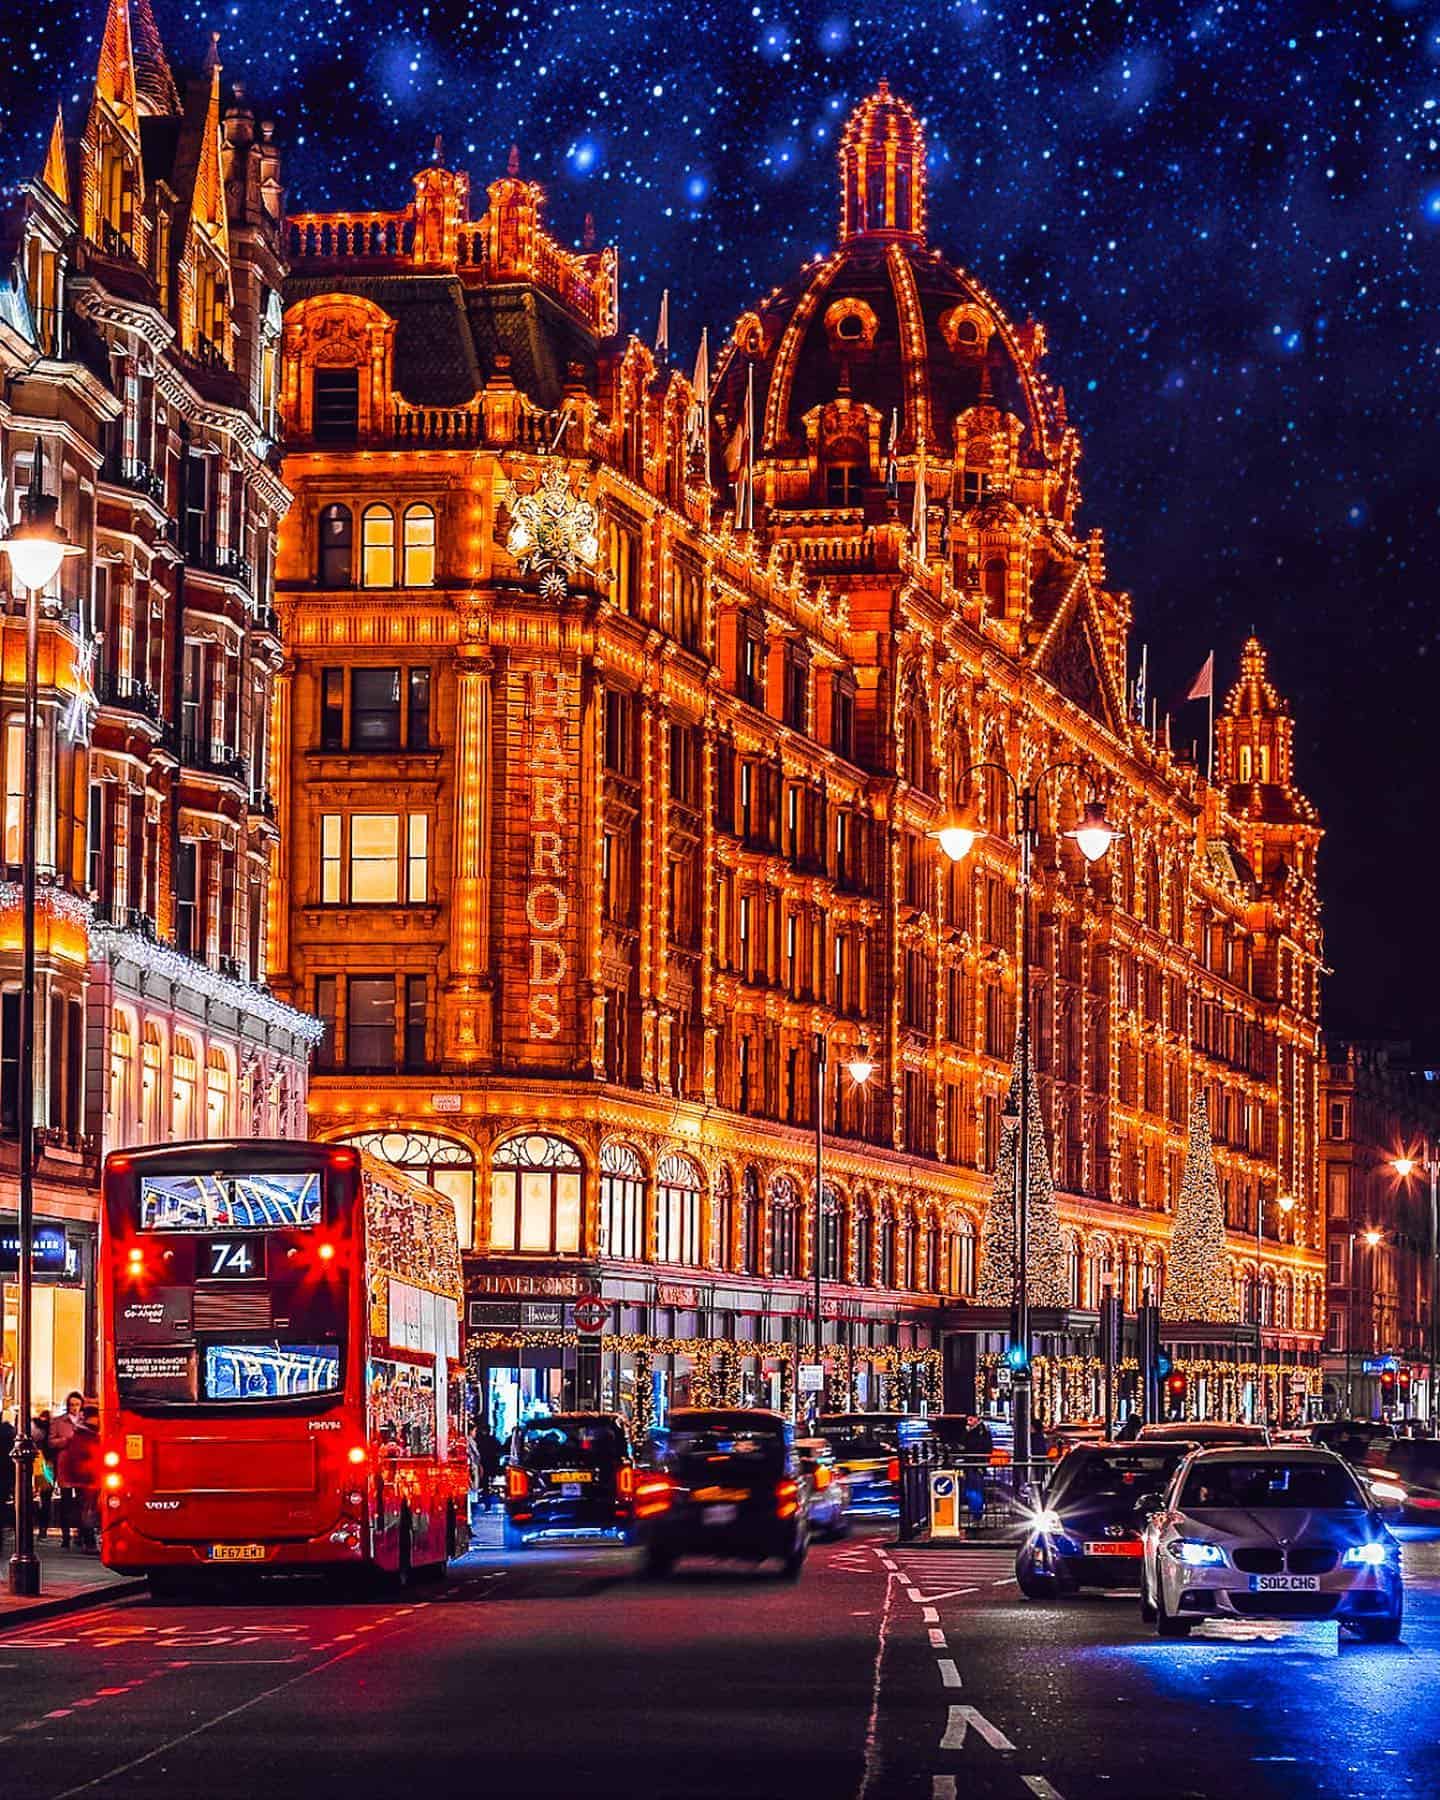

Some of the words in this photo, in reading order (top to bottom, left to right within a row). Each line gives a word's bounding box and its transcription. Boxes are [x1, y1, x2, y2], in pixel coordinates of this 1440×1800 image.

[527, 671, 569, 1039] HARRODS
[32, 1239, 59, 1249] AKER
[211, 1244, 252, 1274] 74
[1291, 1577, 1316, 1589] CHG
